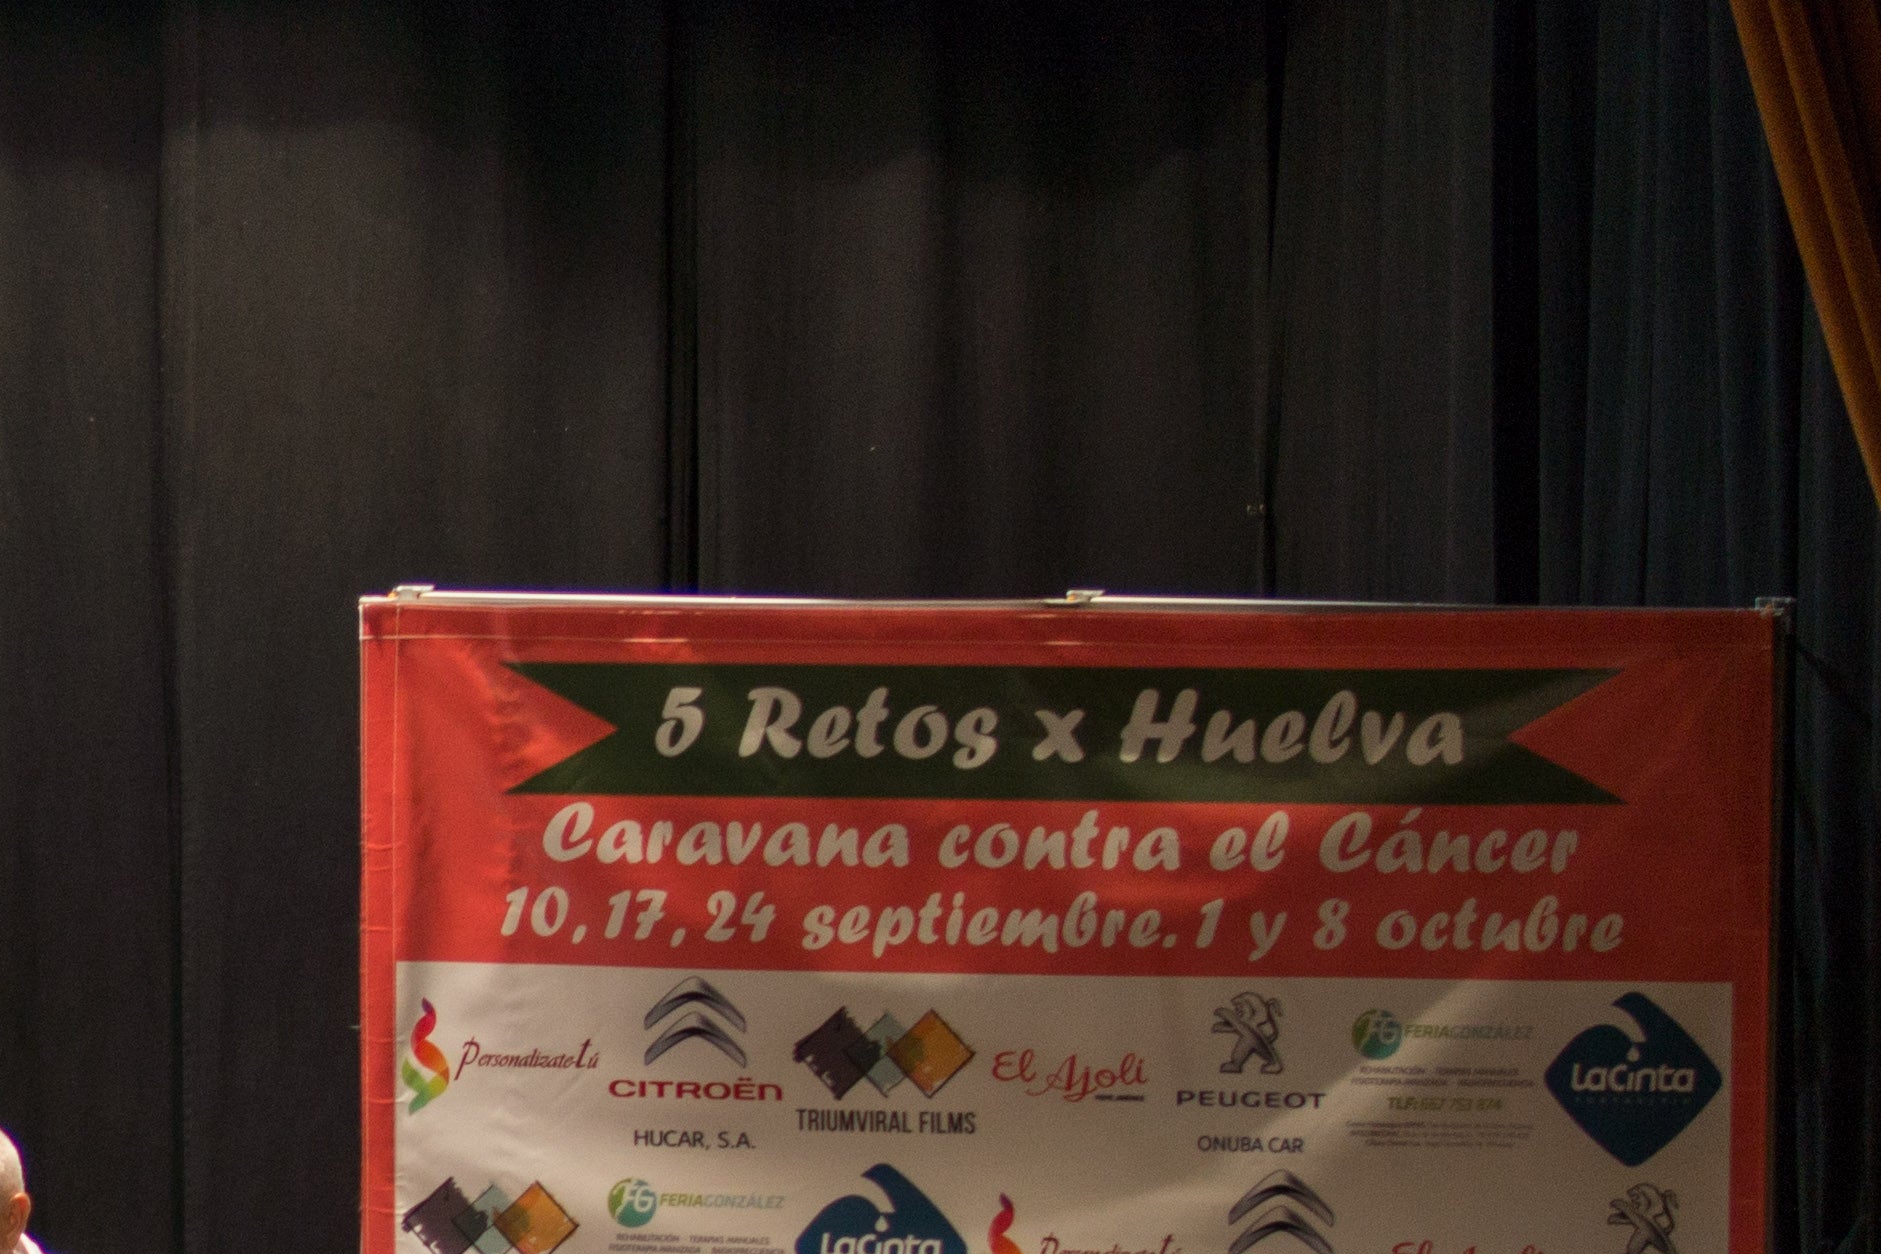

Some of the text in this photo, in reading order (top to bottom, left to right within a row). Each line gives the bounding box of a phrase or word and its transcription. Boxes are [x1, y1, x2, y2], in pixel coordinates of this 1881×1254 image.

[655, 686, 1465, 770] 5 Retos x Huelva
[541, 800, 1580, 875] Caravana contra el Cáncer
[1195, 897, 1225, 949] 1
[1248, 908, 1288, 963] y
[1313, 897, 1351, 950] 8
[1376, 895, 1624, 953] octubre
[991, 1048, 1038, 1084] El
[1176, 1090, 1327, 1109] PEUGEOT
[796, 1107, 977, 1135] TRIUMVIRAL FILMS
[633, 1129, 757, 1151] HUCAR, S.A.
[1197, 1136, 1304, 1154] ONUBA CAR
